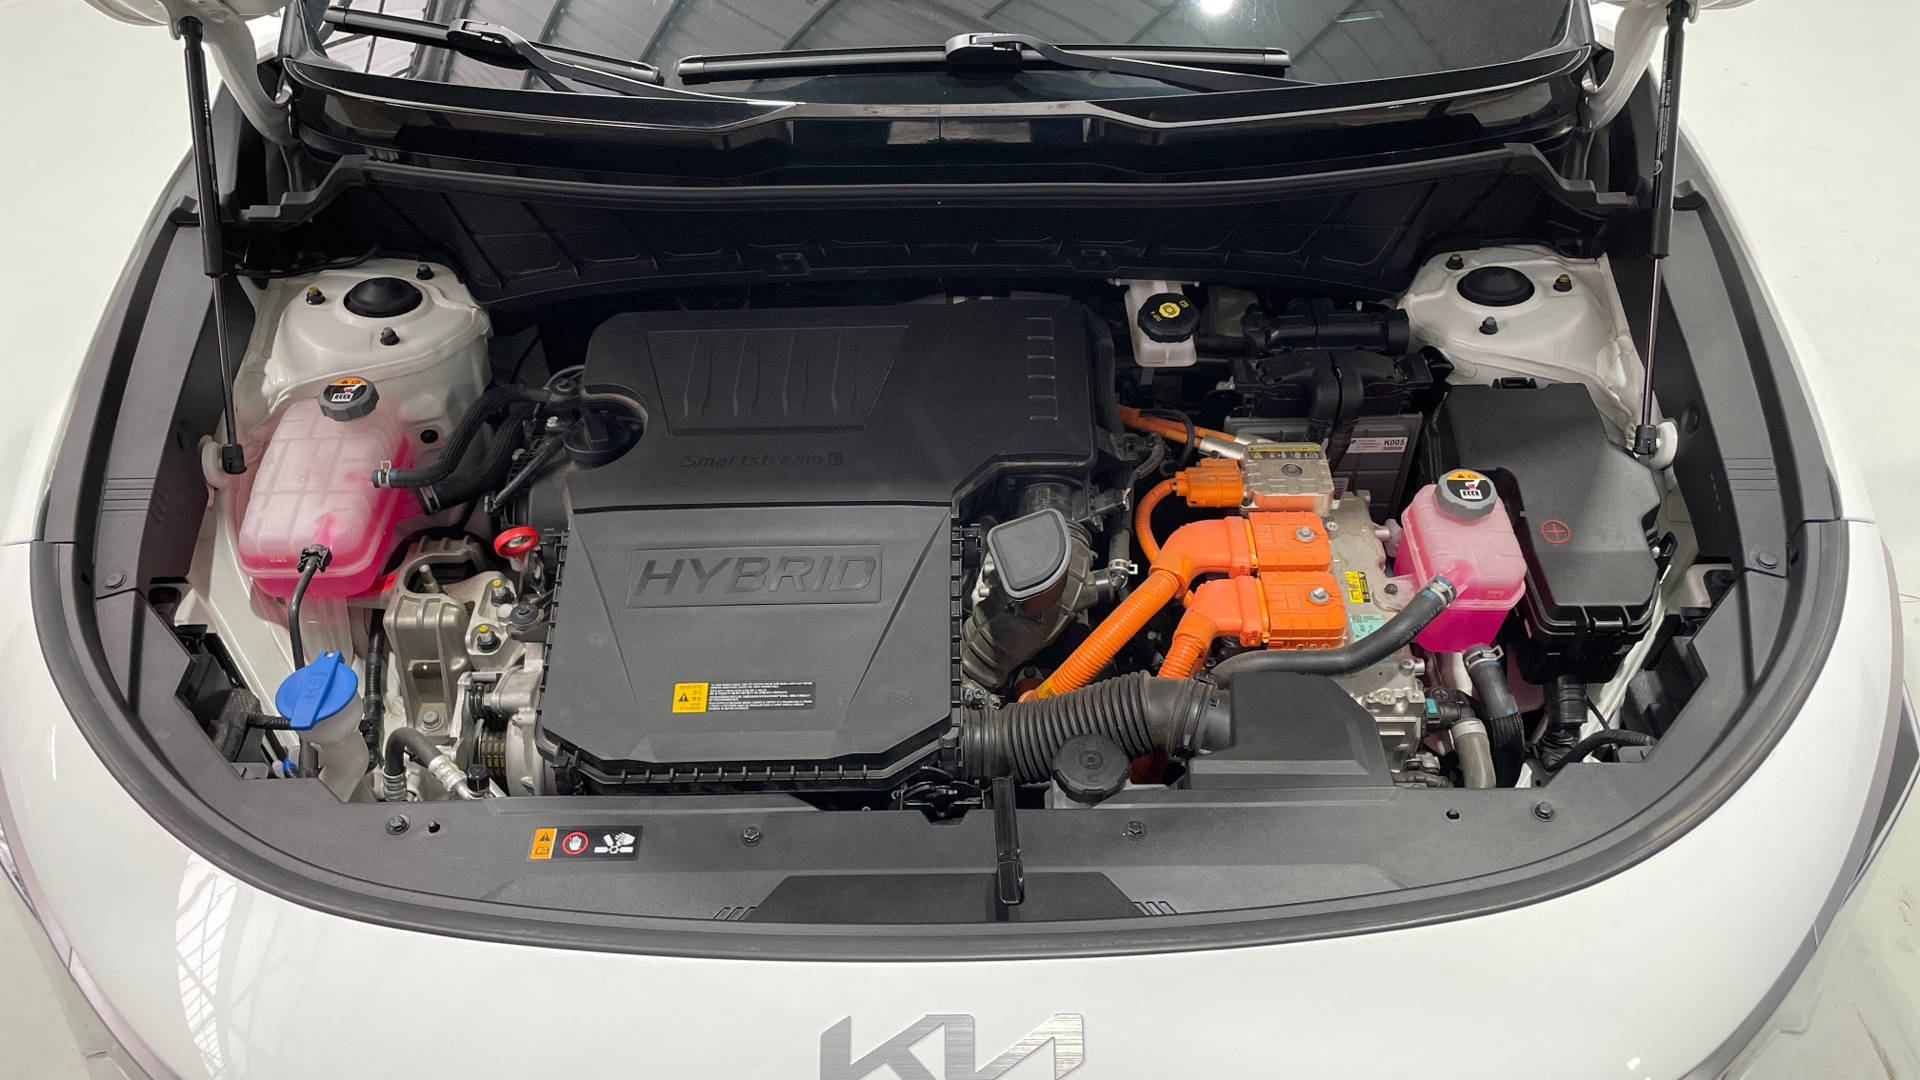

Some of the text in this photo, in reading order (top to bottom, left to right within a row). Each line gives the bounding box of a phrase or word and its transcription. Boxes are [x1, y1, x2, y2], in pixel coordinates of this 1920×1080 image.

[1384, 438, 1405, 446] K005
[682, 454, 824, 467] Smartstream
[633, 555, 877, 595] HYBRID
